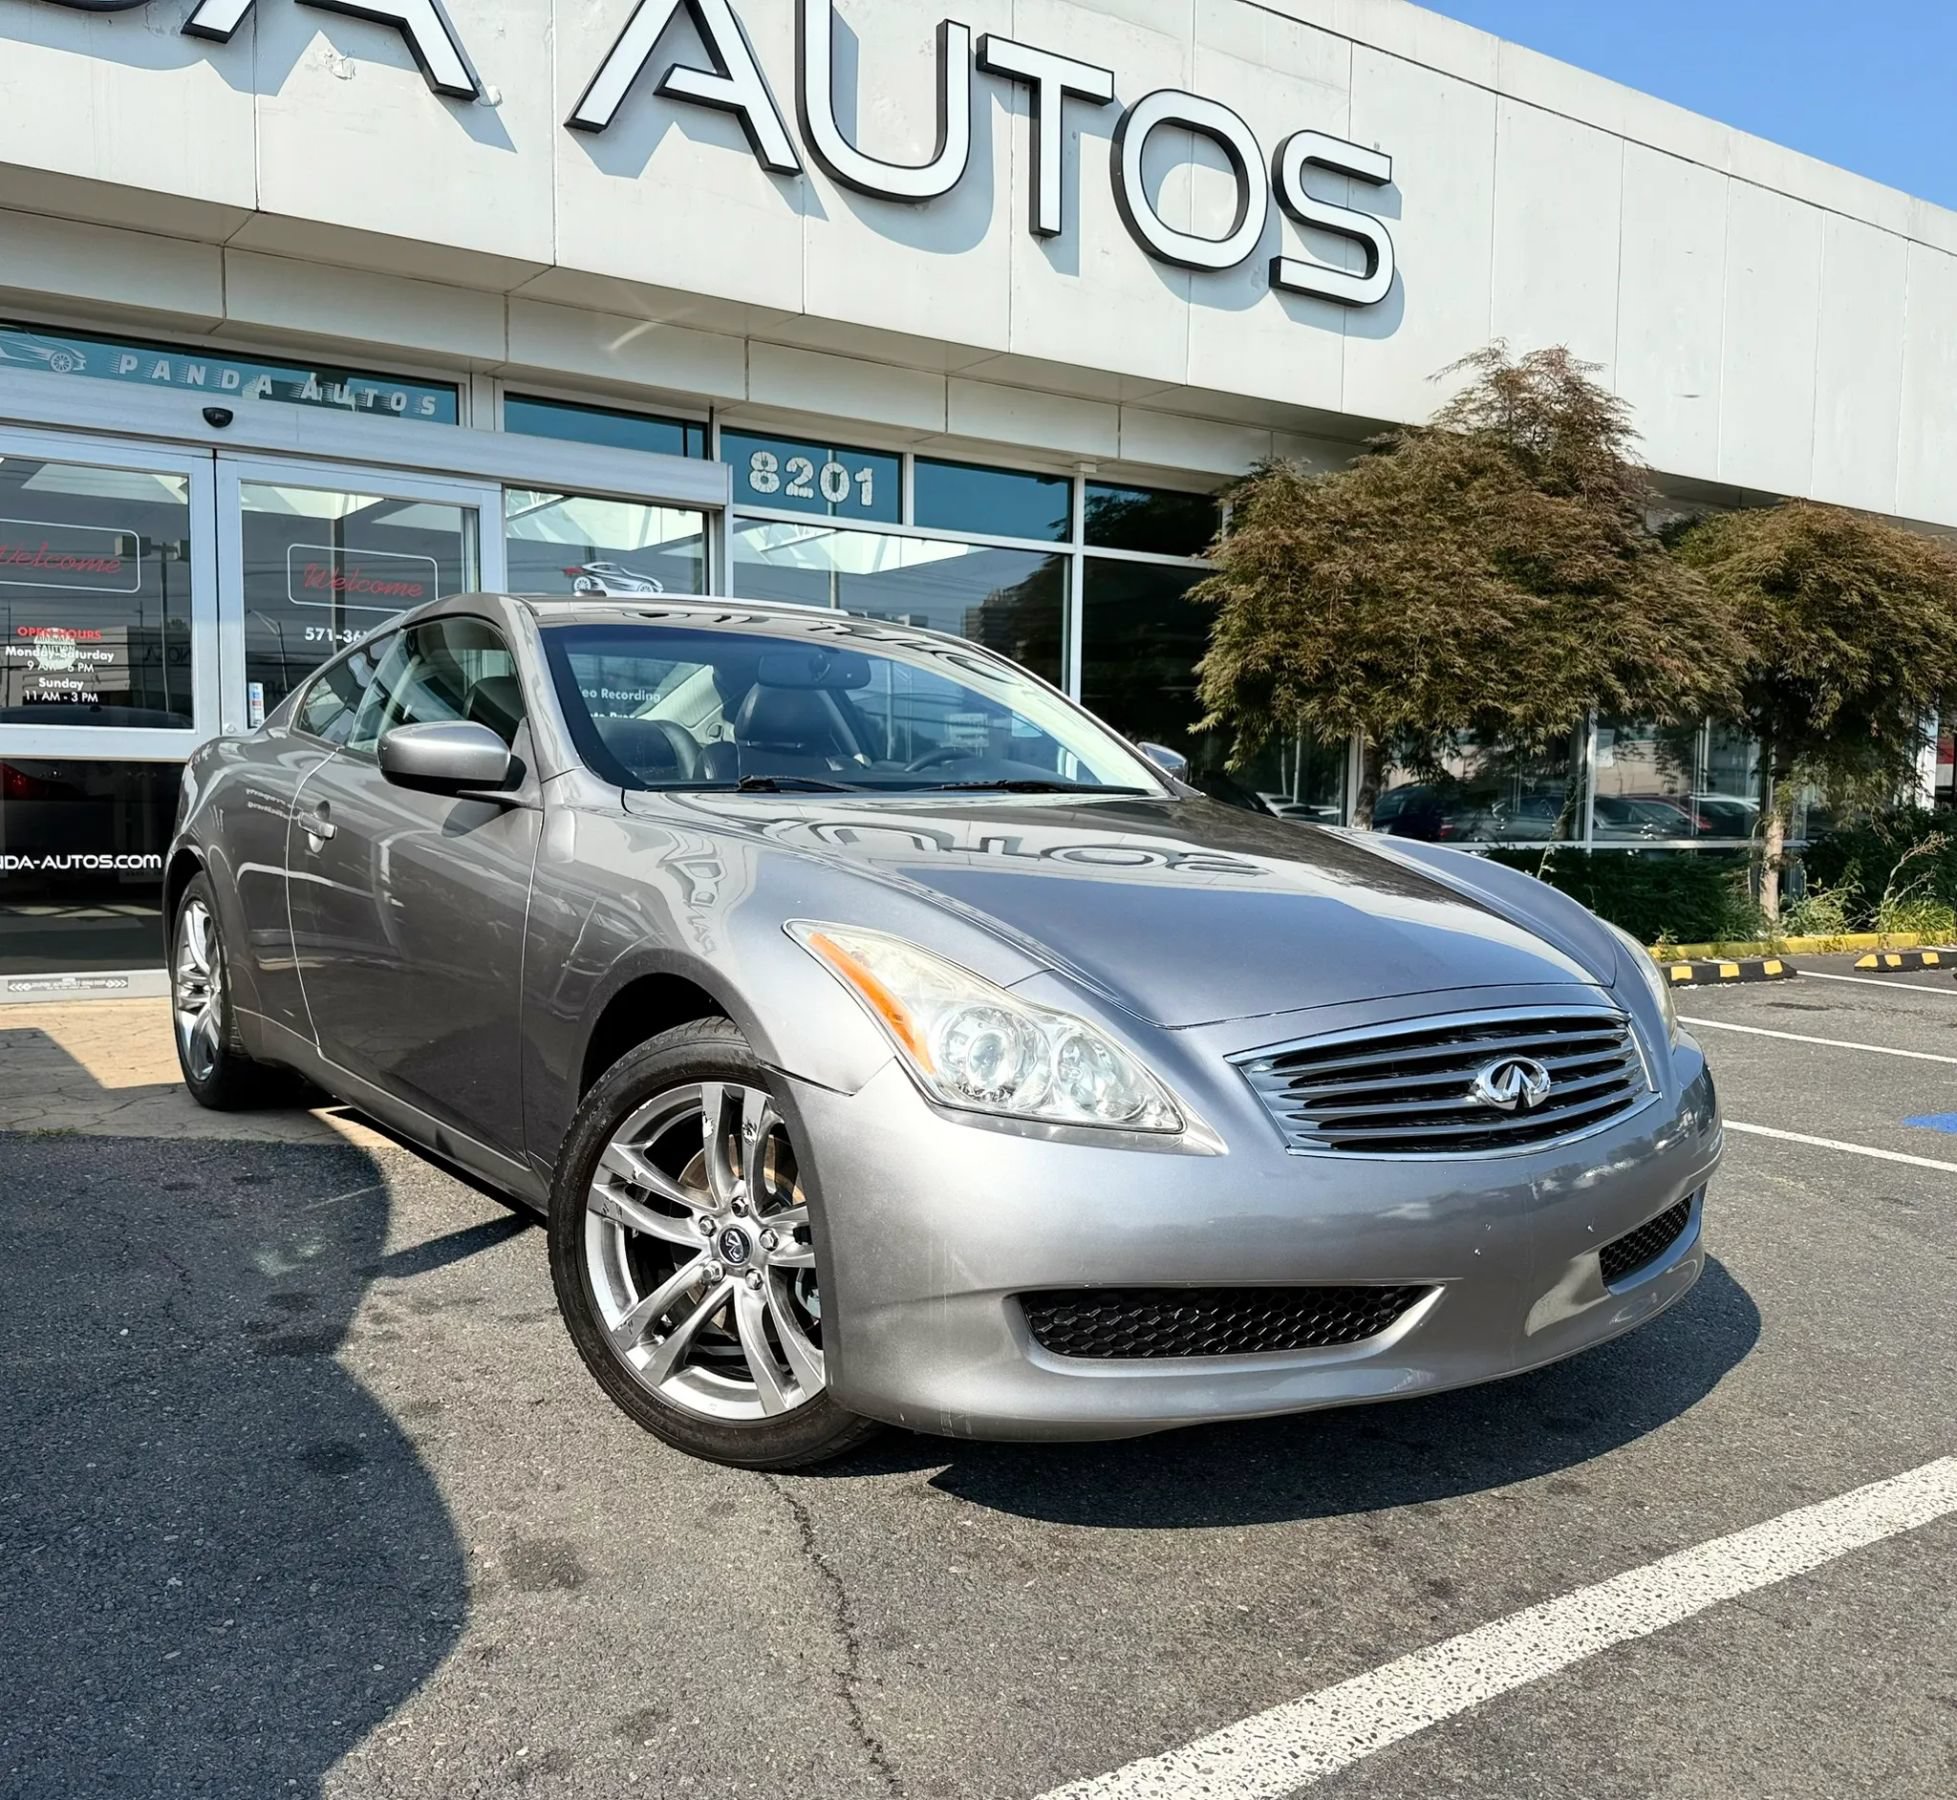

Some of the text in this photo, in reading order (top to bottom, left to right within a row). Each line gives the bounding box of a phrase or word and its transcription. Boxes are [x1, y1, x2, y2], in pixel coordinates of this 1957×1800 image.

[565, 0, 1395, 305] AUTOS
[112, 352, 437, 416] PANDA AUTOS
[749, 451, 873, 506] 8201
[304, 562, 424, 597] Welcome
[5, 645, 114, 663] Monday-Saturday
[27, 660, 34, 671] 9
[67, 662, 74, 672] 6
[78, 663, 94, 673] PM
[39, 677, 84, 690] Sunday
[25, 690, 37, 700] 11
[42, 691, 60, 701] AM
[71, 692, 78, 702] 3
[82, 692, 98, 702] PM
[601, 688, 661, 702] Recording
